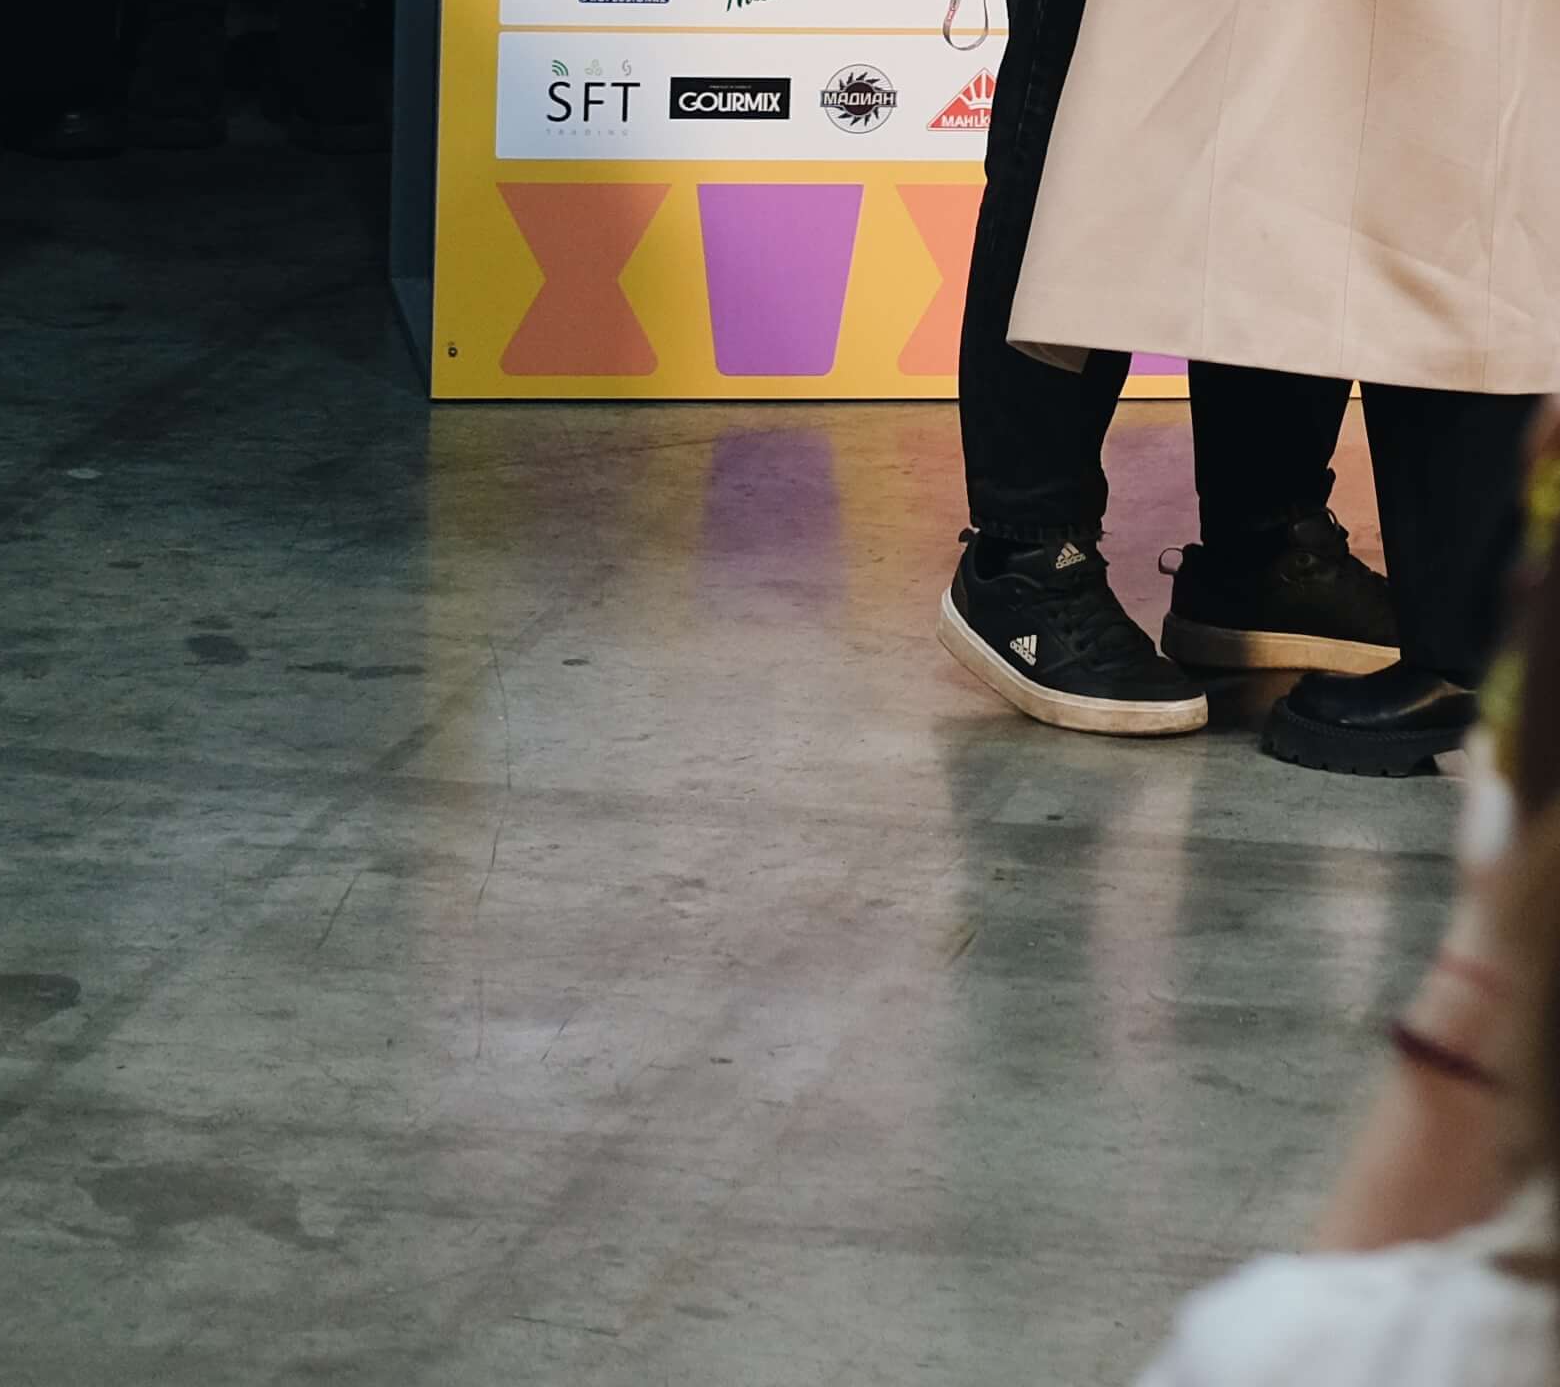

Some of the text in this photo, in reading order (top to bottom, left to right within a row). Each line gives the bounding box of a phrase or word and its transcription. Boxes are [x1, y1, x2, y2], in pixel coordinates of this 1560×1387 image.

[546, 82, 641, 122] SFT
[678, 92, 781, 112] GOURMIX
[822, 91, 897, 108] МАДИАН
